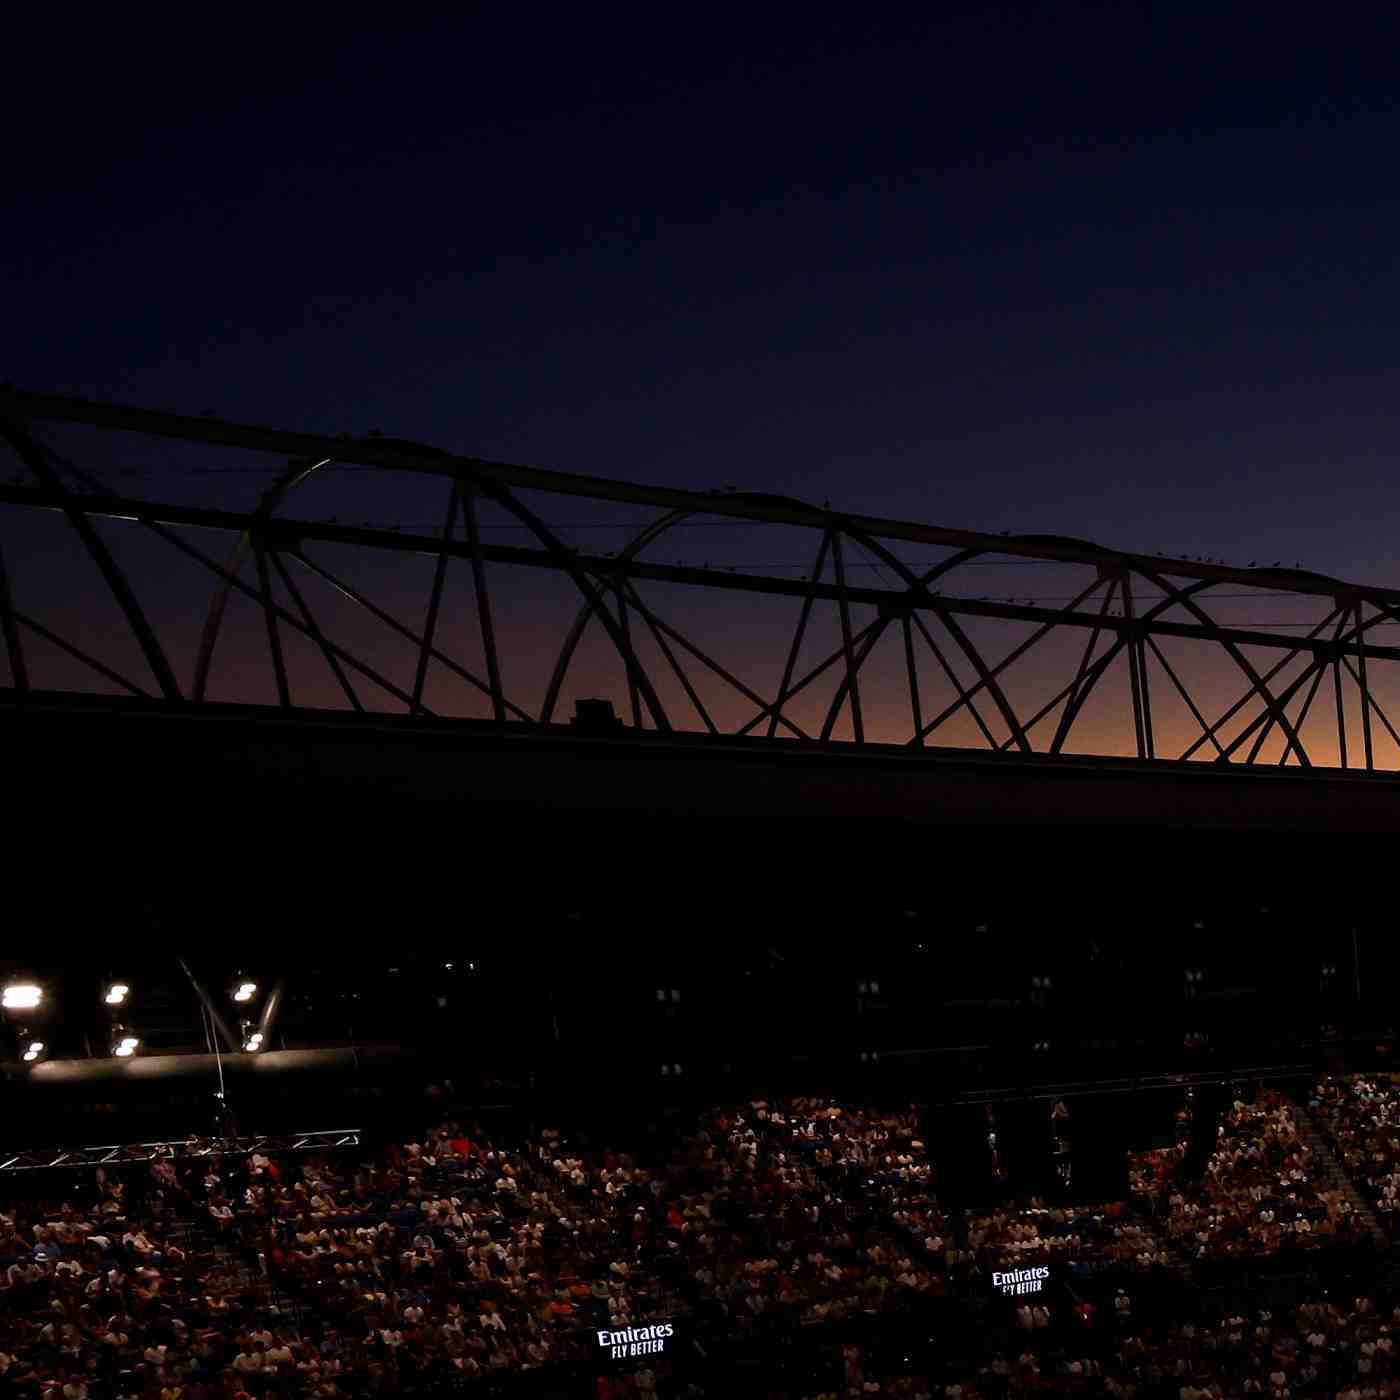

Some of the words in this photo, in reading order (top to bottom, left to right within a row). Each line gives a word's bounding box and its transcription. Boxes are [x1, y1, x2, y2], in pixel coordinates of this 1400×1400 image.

[992, 1266, 1049, 1286] Emirates
[1017, 1280, 1042, 1294] BETTER
[597, 1323, 673, 1346] Emirates
[612, 1344, 627, 1359] FLY
[630, 1339, 664, 1356] BETTER
